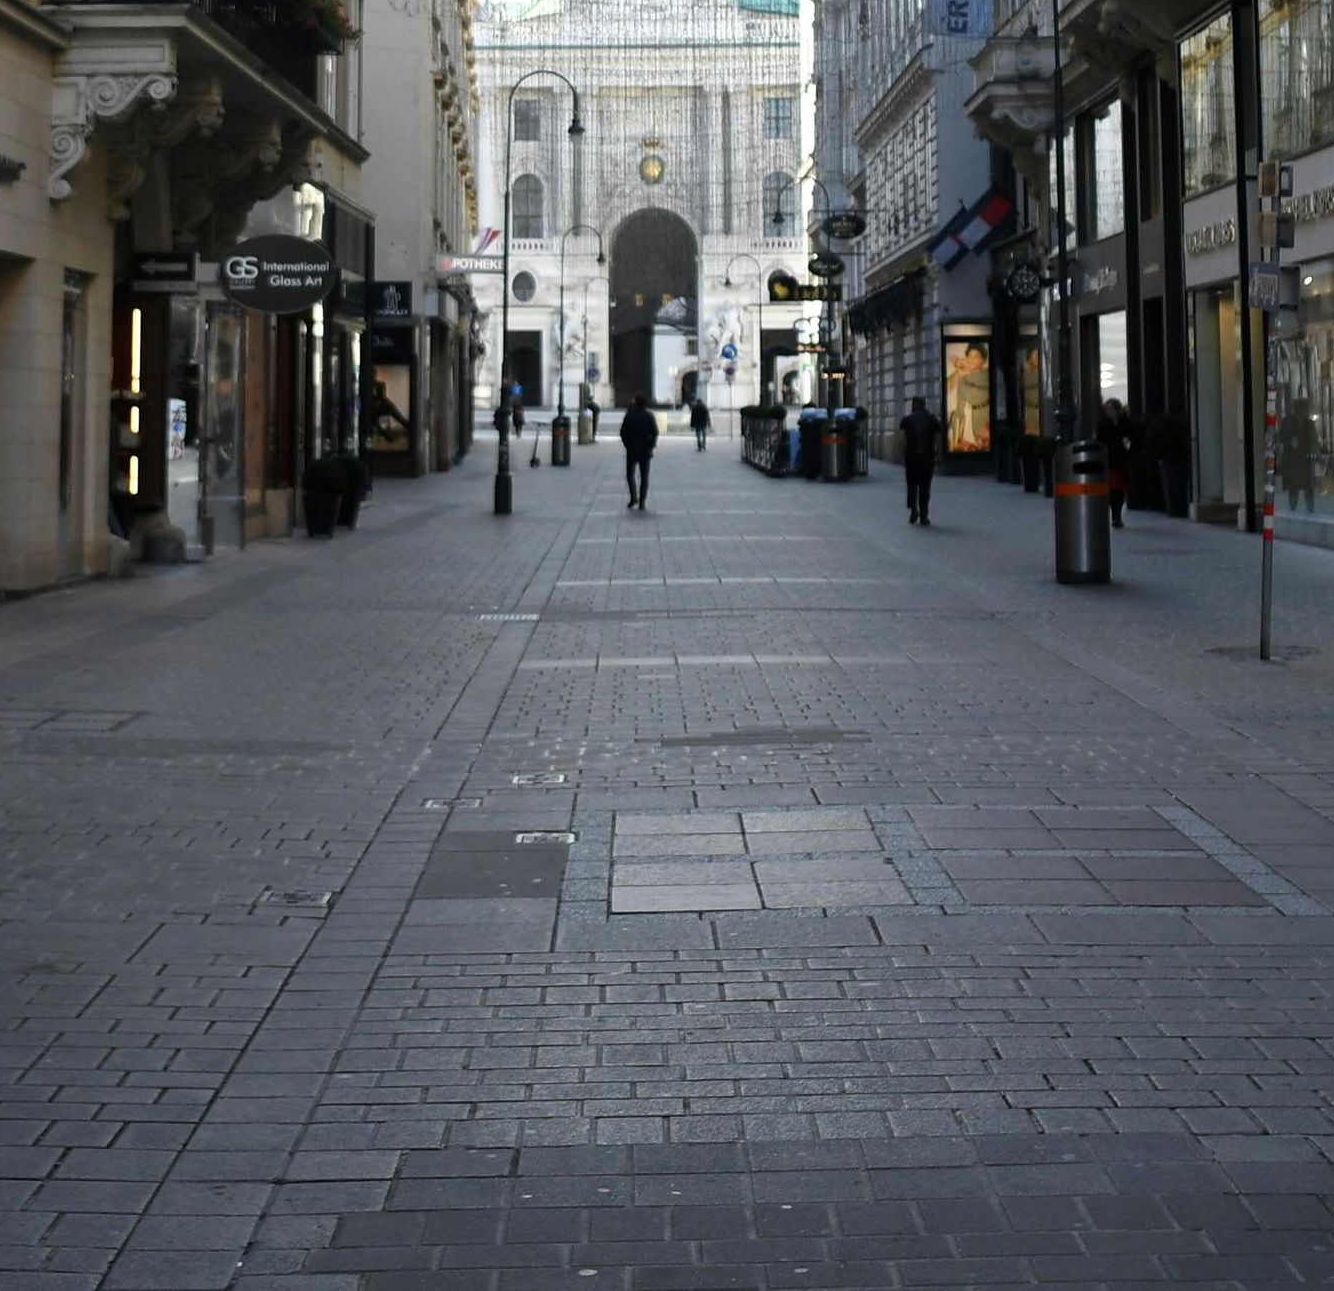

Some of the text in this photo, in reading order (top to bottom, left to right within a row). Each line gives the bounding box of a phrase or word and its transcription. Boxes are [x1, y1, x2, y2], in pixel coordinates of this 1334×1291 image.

[227, 256, 259, 279] GS
[263, 261, 330, 272] International
[270, 275, 323, 287] Glass Art
